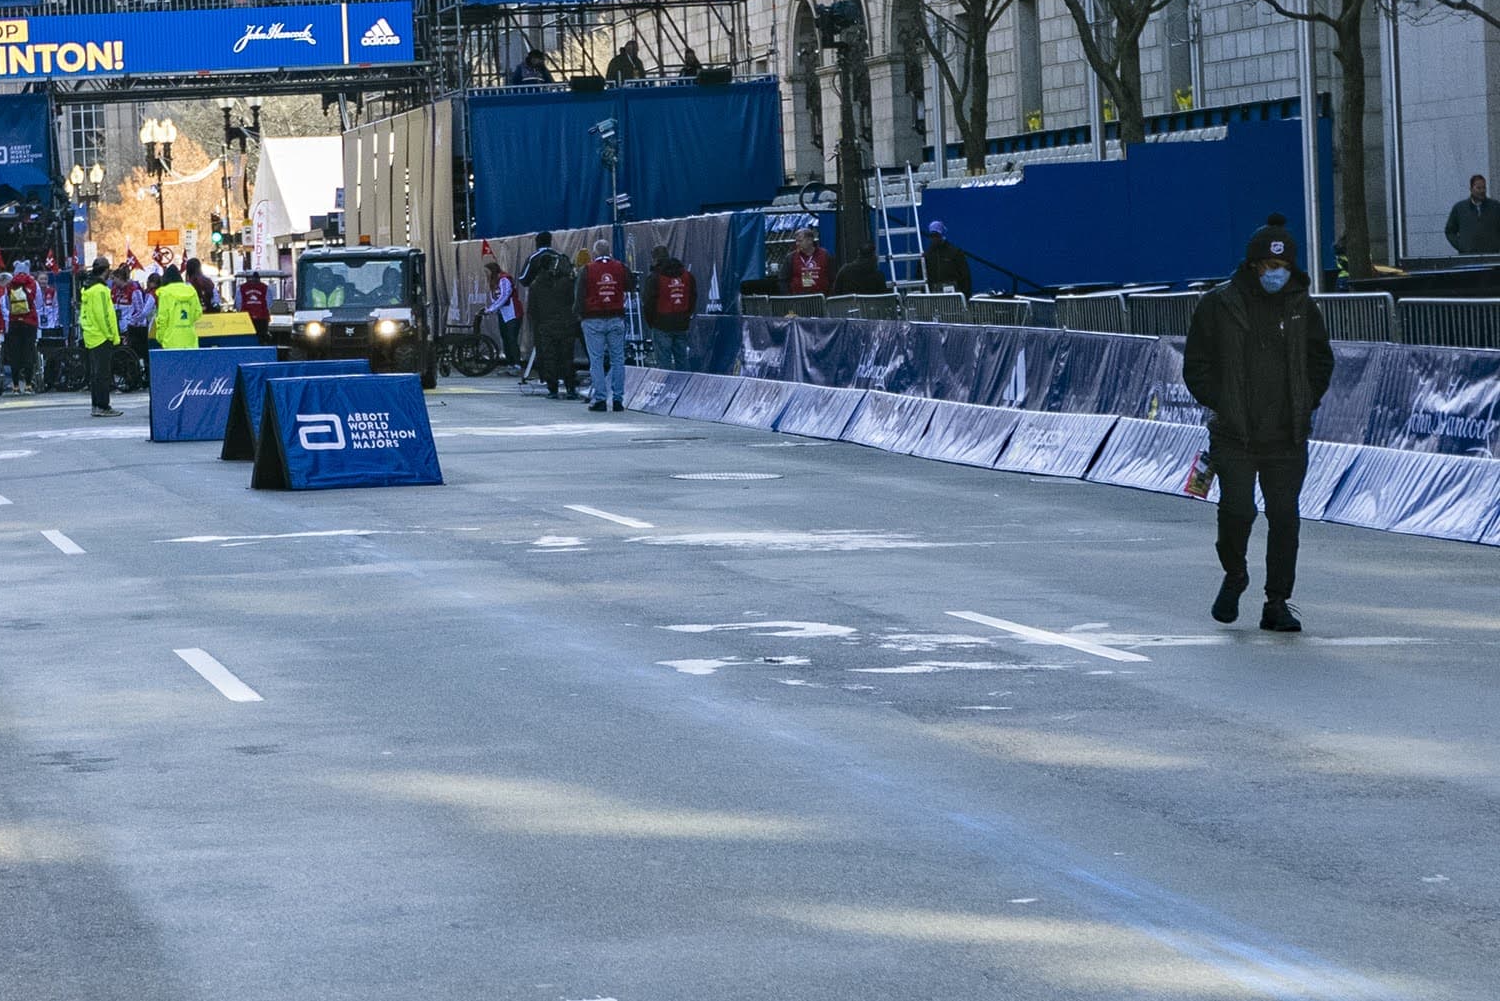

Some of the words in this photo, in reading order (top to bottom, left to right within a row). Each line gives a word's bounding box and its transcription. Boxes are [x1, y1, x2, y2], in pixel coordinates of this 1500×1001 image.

[233, 23, 270, 53] John
[268, 22, 317, 46] Hancock
[361, 34, 401, 47] adidas
[167, 379, 208, 411] John
[347, 412, 389, 423] ABBOTT
[348, 421, 390, 432] WORLD
[351, 429, 417, 441] MARATHON
[353, 439, 400, 450] MAJORS
